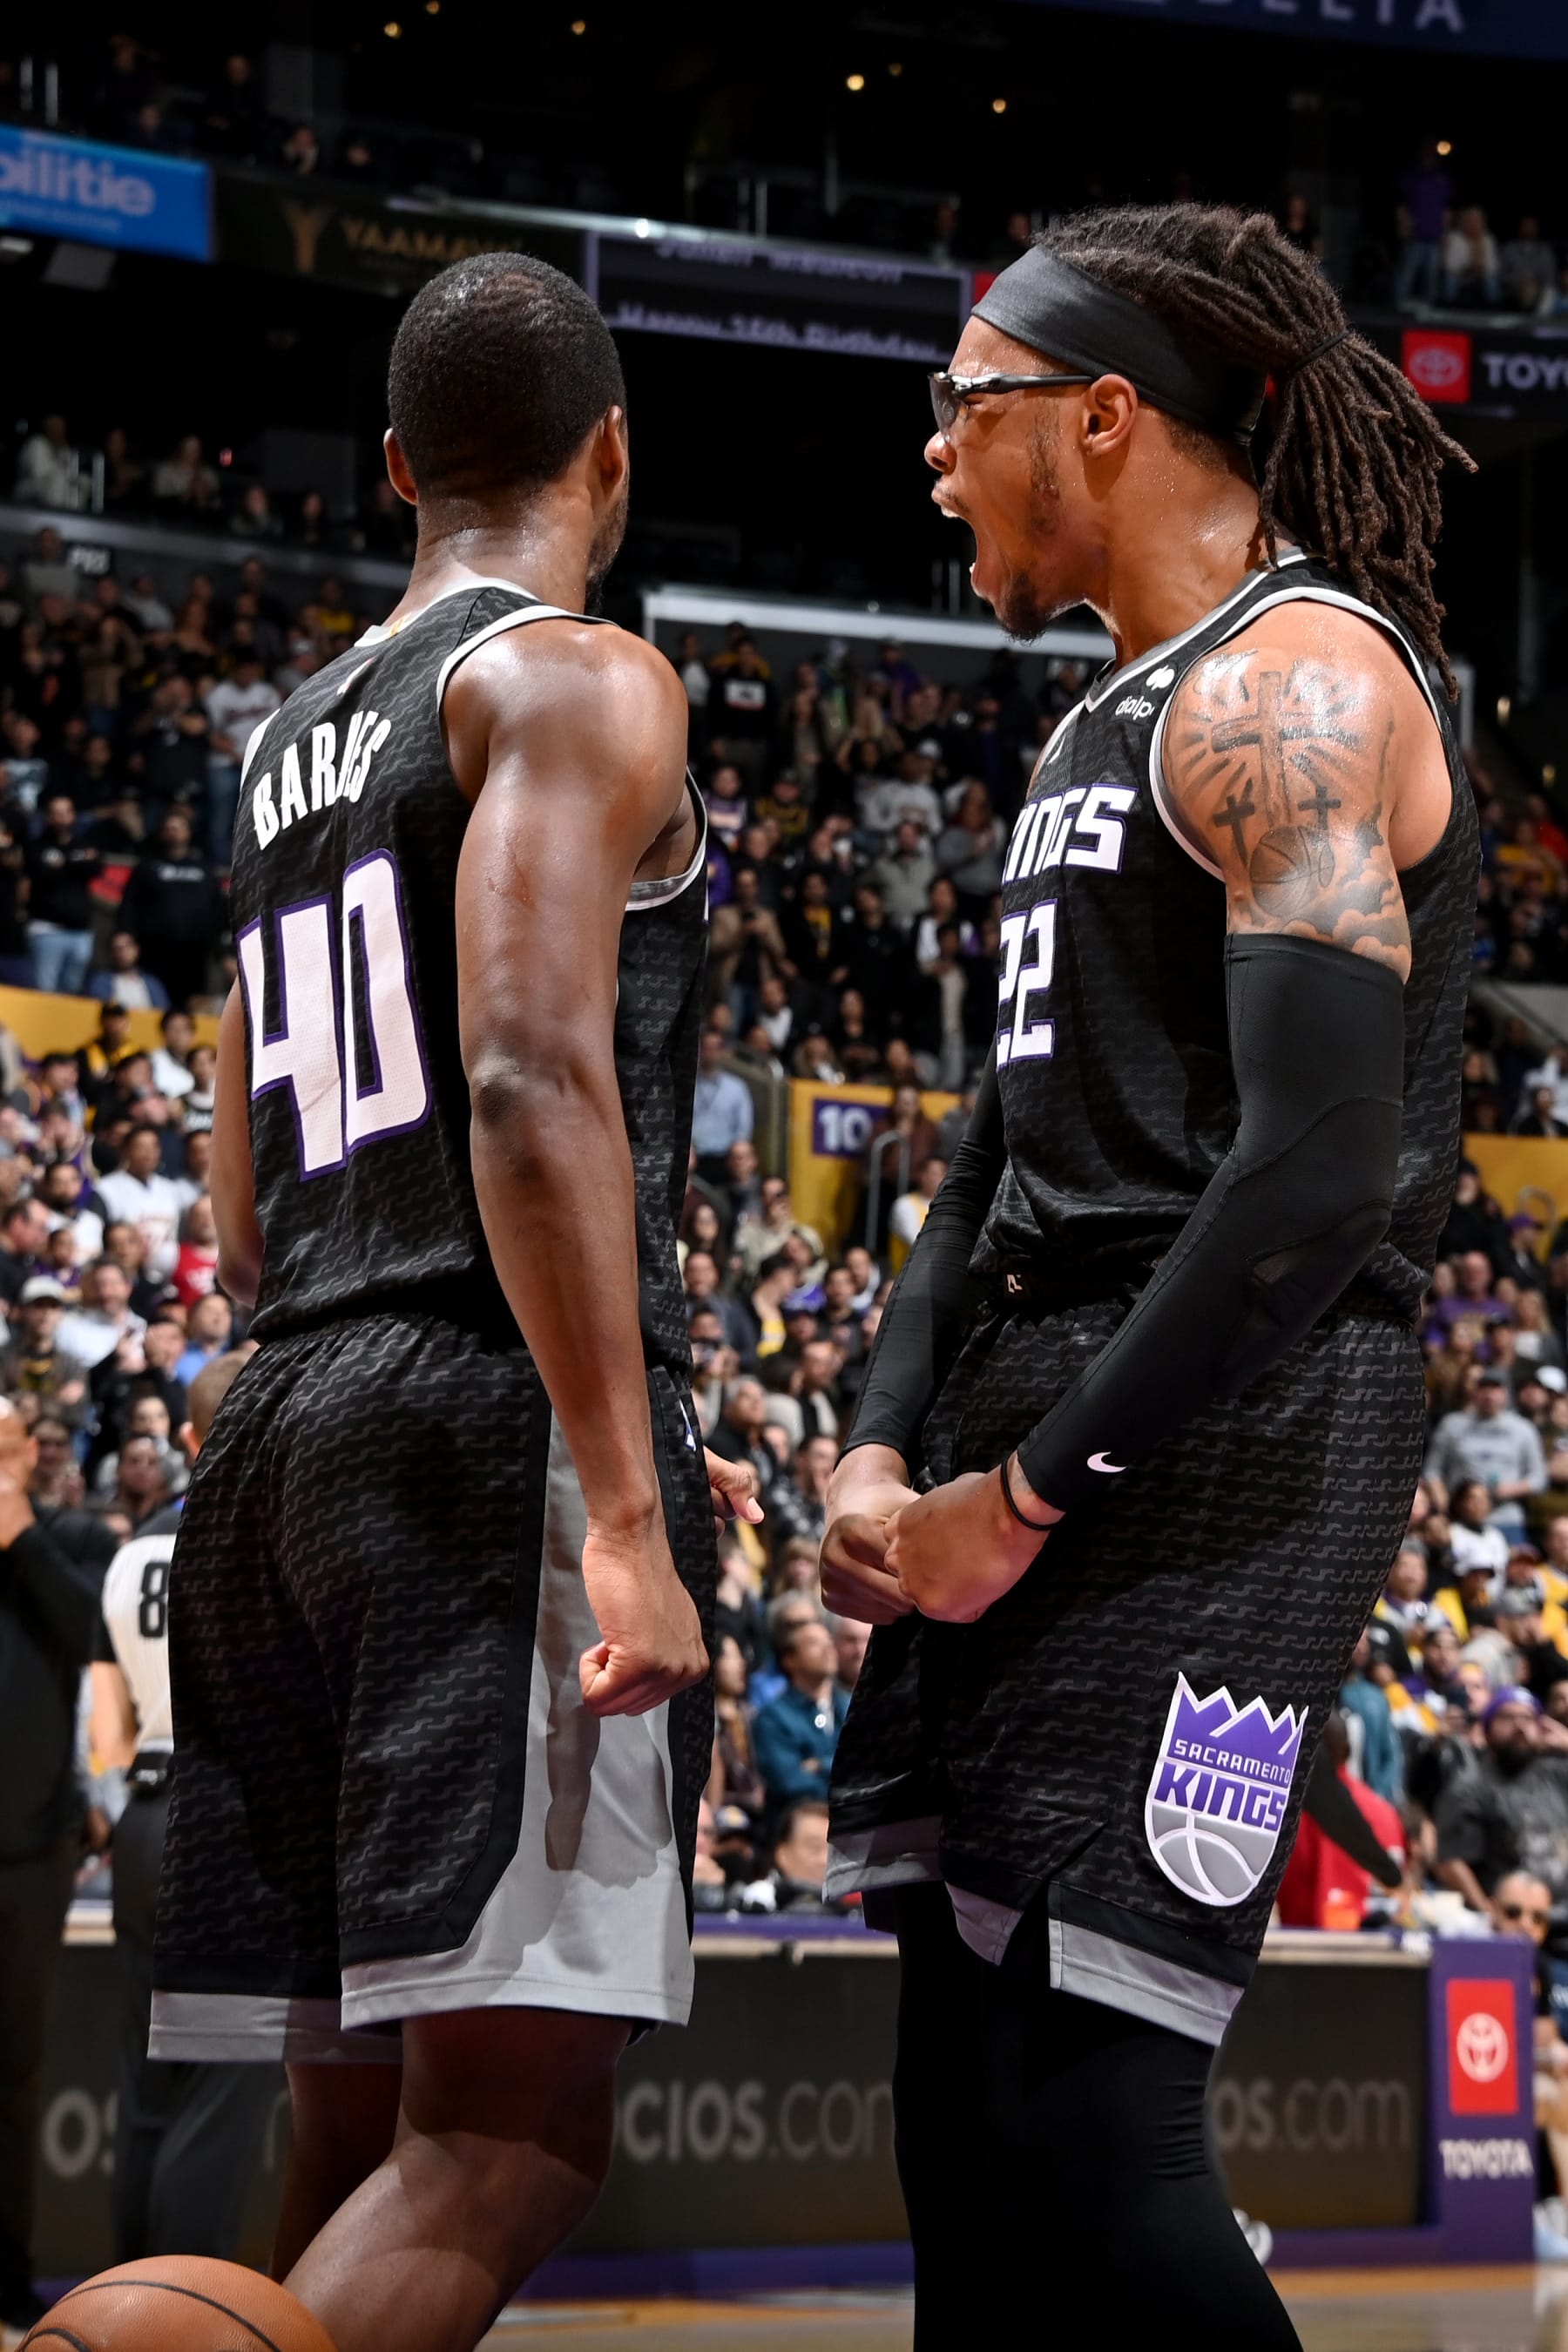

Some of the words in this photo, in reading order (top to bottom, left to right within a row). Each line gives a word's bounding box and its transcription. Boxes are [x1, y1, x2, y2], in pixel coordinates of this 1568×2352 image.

[1480, 351, 1568, 391] TOY
[236, 847, 432, 1182] 40
[997, 897, 1058, 1074] 22
[818, 1104, 872, 1152] 10
[139, 1560, 171, 1639] 8
[1173, 1738, 1292, 1785] SACRAMENTO
[1153, 1761, 1288, 1831] KINGS
[1437, 2138, 1534, 2180] TOYOTA
